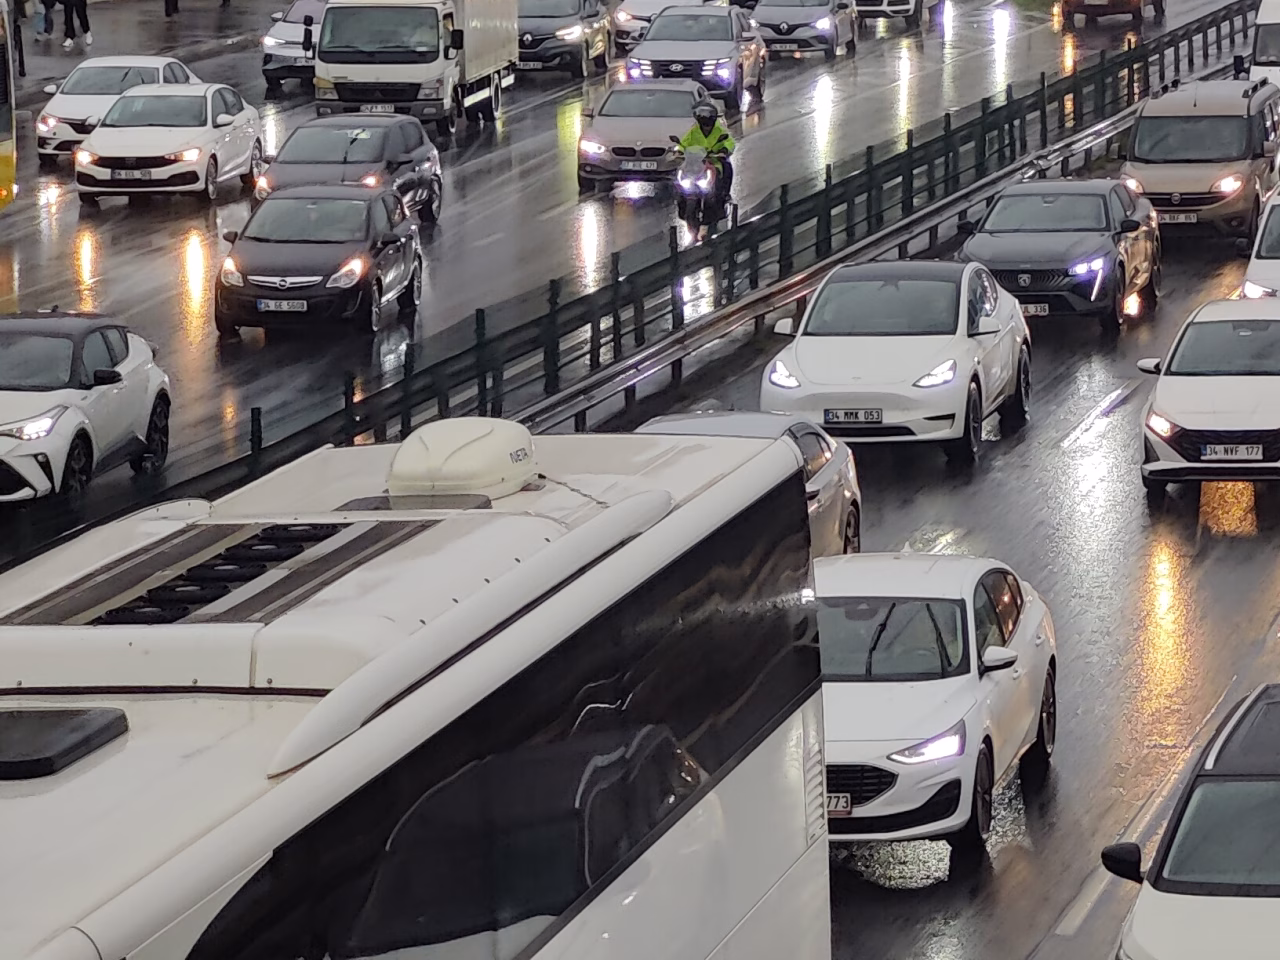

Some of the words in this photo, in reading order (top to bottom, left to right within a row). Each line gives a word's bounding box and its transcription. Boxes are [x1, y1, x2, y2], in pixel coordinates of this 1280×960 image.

[1034, 304, 1048, 313] 336
[829, 411, 840, 421] 34
[843, 411, 859, 420] MMK
[863, 411, 880, 420] 053
[1207, 446, 1218, 456] 34
[1223, 446, 1240, 455] NVF
[1246, 446, 1261, 455] 177
[826, 795, 849, 809] 773
